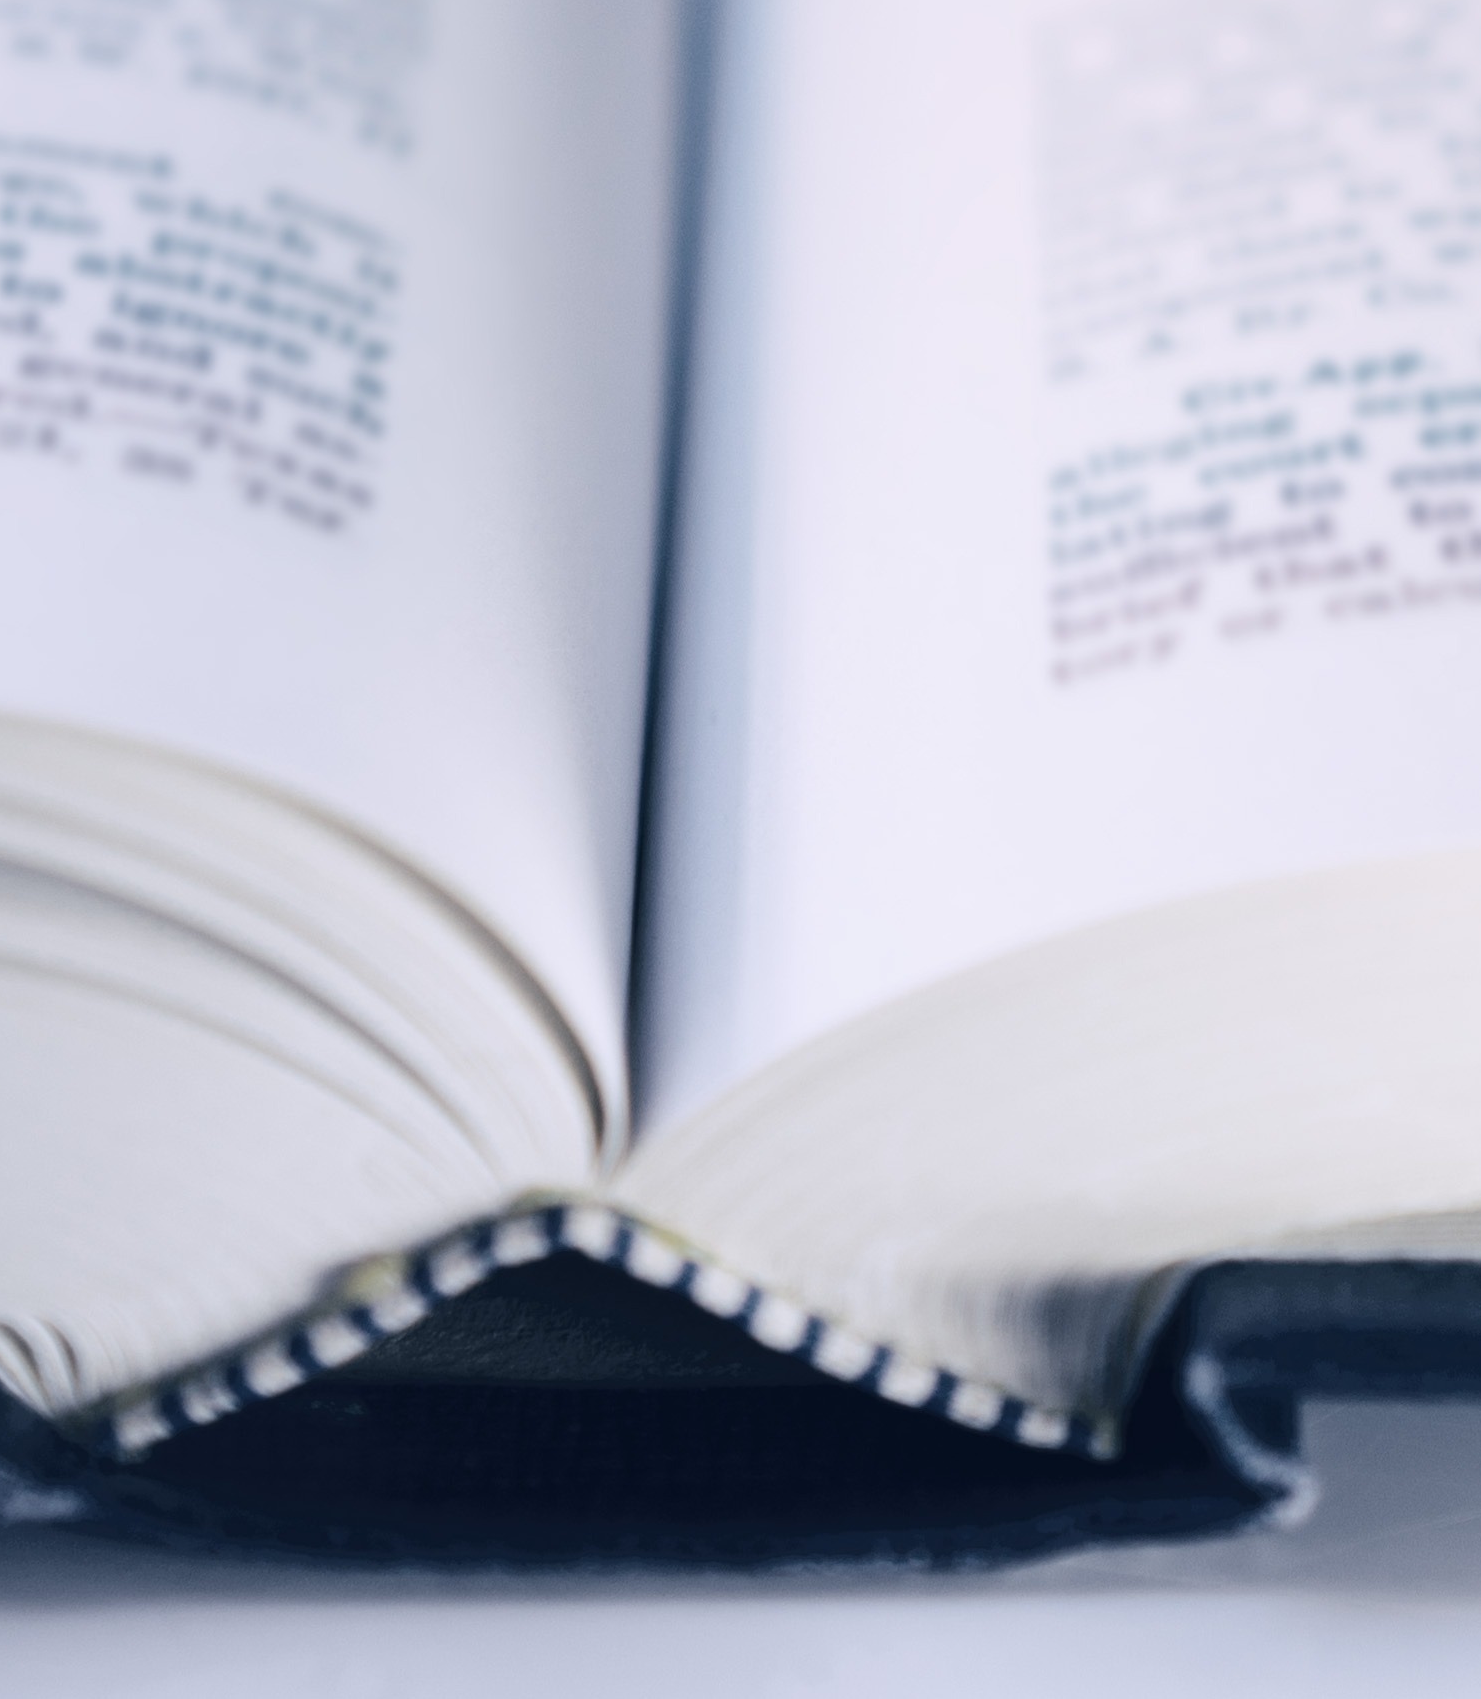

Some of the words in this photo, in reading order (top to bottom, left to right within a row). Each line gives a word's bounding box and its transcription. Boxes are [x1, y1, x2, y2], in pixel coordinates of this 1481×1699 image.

[134, 189, 316, 261] which
[74, 253, 391, 366] abstractly
[110, 291, 313, 367] ignore
[19, 353, 263, 425] general
[91, 326, 212, 374] and
[244, 365, 385, 439] such
[1049, 409, 1296, 493] alleging
[1049, 484, 1149, 528] the
[1198, 430, 1364, 488] court
[1049, 499, 1235, 567] lating
[1279, 478, 1346, 509] to
[1049, 513, 1337, 605] sufficient
[1408, 498, 1475, 529] to
[1049, 577, 1203, 645] brief
[1253, 542, 1390, 593] that
[1049, 629, 1185, 689] tory
[1217, 605, 1285, 643] or
